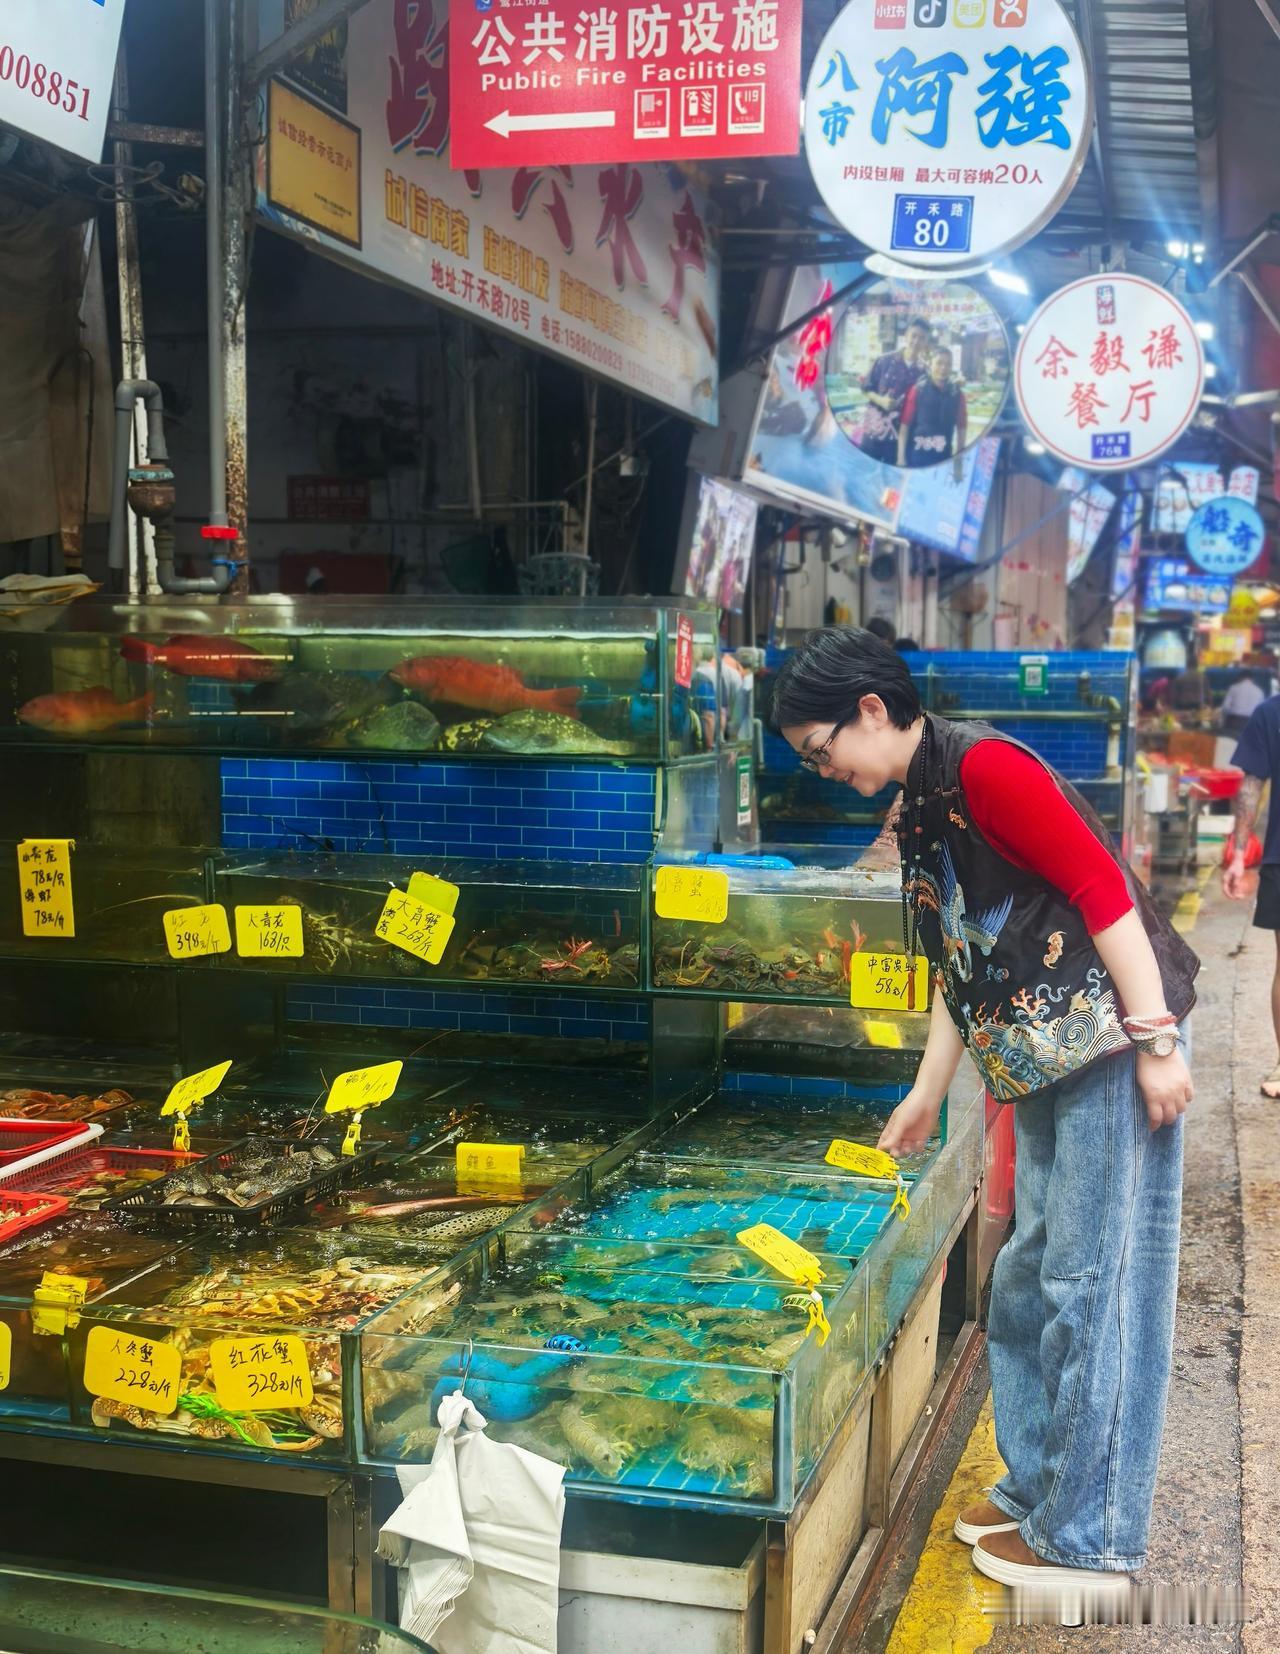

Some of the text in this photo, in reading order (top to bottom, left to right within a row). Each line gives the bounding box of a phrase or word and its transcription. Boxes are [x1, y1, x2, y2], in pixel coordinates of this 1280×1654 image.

[876, 4, 906, 18] 小红书
[471, 1, 779, 67] 公共消防设施
[0, 46, 90, 121] 008851
[482, 60, 767, 91] Public Fire Facilities
[745, 90, 759, 102] 119
[818, 49, 860, 146] 八市
[871, 45, 1071, 150] 阿强
[843, 163, 1043, 184] 内设包厢 最大可容纳20人
[384, 169, 469, 258] 诚信商家
[904, 202, 964, 217] 开禾路
[914, 219, 949, 245] 80
[1034, 324, 1183, 379] 余毅谦
[1065, 380, 1157, 429] 餐厅
[115, 1368, 171, 1398] 228元/斤
[248, 1372, 303, 1397] 328元/斤
